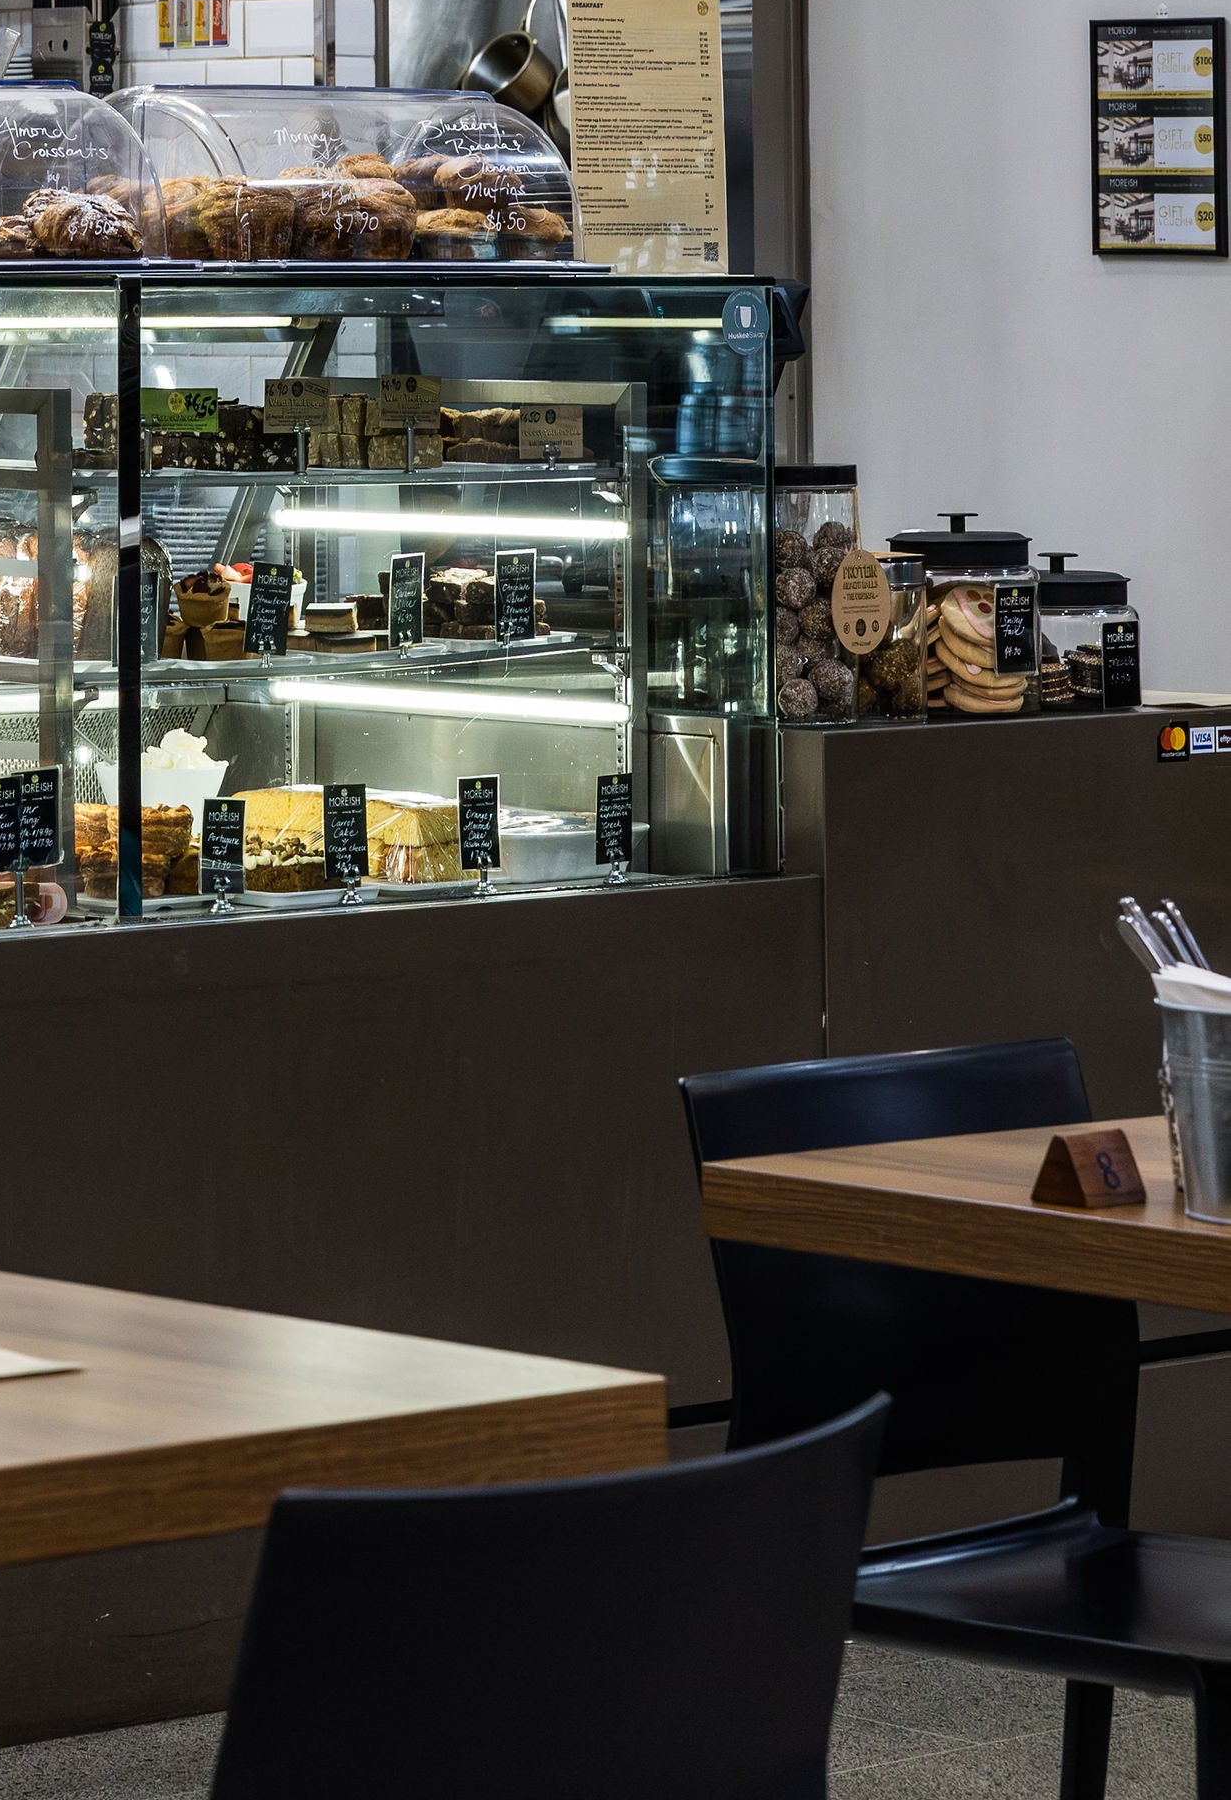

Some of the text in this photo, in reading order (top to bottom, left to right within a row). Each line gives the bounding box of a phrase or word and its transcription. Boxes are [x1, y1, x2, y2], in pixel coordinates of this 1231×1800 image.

[571, 1, 604, 9] BREAKFAST
[1108, 26, 1137, 35] MOREISH
[1195, 56, 1213, 66] $100
[1108, 102, 1138, 111] MOREISH
[1158, 129, 1183, 142] GIFT
[1198, 133, 1212, 143] $50
[1109, 178, 1138, 187] MOREISH
[459, 176, 526, 204] Muffins
[1158, 205, 1184, 218] GIFT
[1197, 210, 1215, 223] $20
[333, 210, 380, 239] $7.90
[485, 208, 527, 241] $6.50
[501, 564, 529, 575] MOREISH
[842, 565, 878, 580] PROTEIN
[257, 574, 289, 586] MOREISH
[1000, 596, 1030, 607] MOREISH
[1106, 632, 1135, 643] MOREISH
[1194, 733, 1212, 743] VISA
[21, 782, 54, 794] OREISH
[463, 788, 494, 799] MOREISH
[600, 784, 629, 796] MOREISH
[329, 796, 361, 807] MOREISH
[208, 811, 240, 821] MOREISH
[331, 817, 356, 828] Carrot
[333, 828, 359, 839] Cake
[1095, 1149, 1122, 1190] 8
